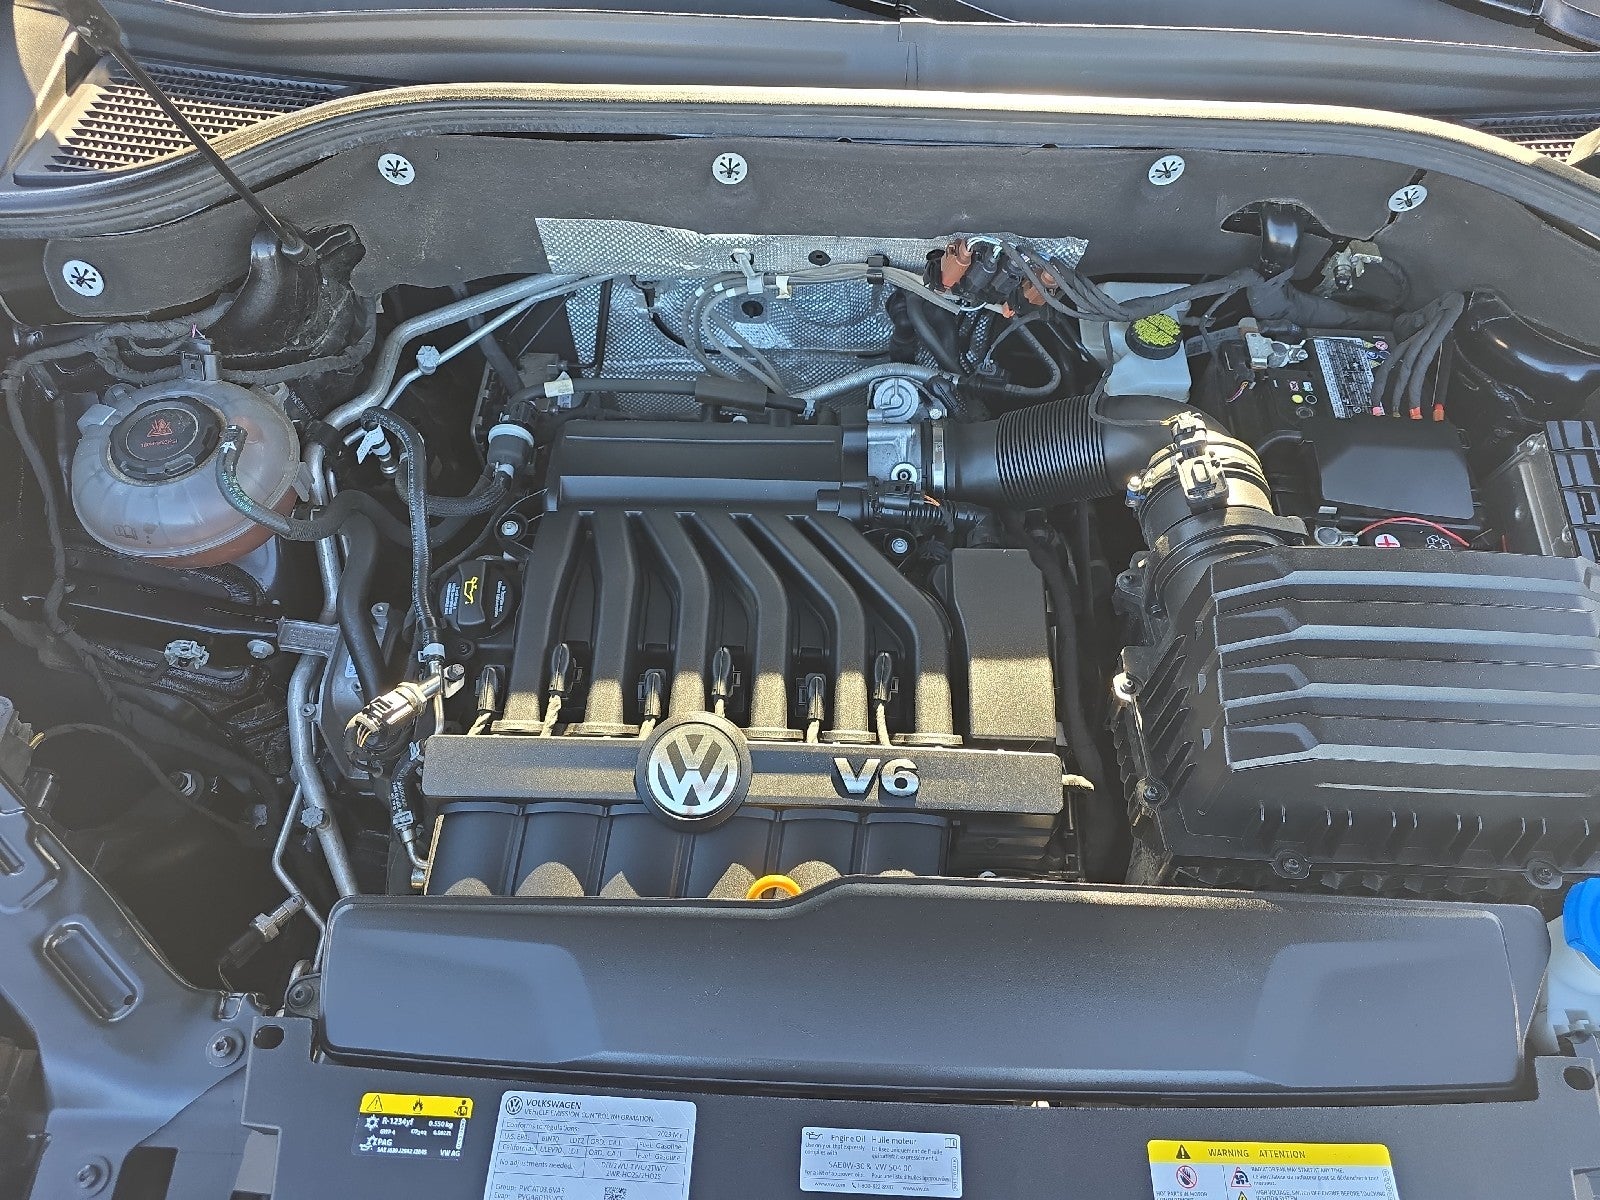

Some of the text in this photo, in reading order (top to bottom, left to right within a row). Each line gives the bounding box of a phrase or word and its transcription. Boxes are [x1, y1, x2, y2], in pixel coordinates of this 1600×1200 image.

[833, 757, 920, 796] V6
[526, 1099, 582, 1109] VOLKSWAGEN
[550, 1110, 580, 1118] EMISSION
[382, 1116, 414, 1127] R-1234yf
[832, 1135, 854, 1143] Engine
[1208, 1148, 1306, 1158] WARNING ATTENTION
[510, 1159, 547, 1168] adjustments
